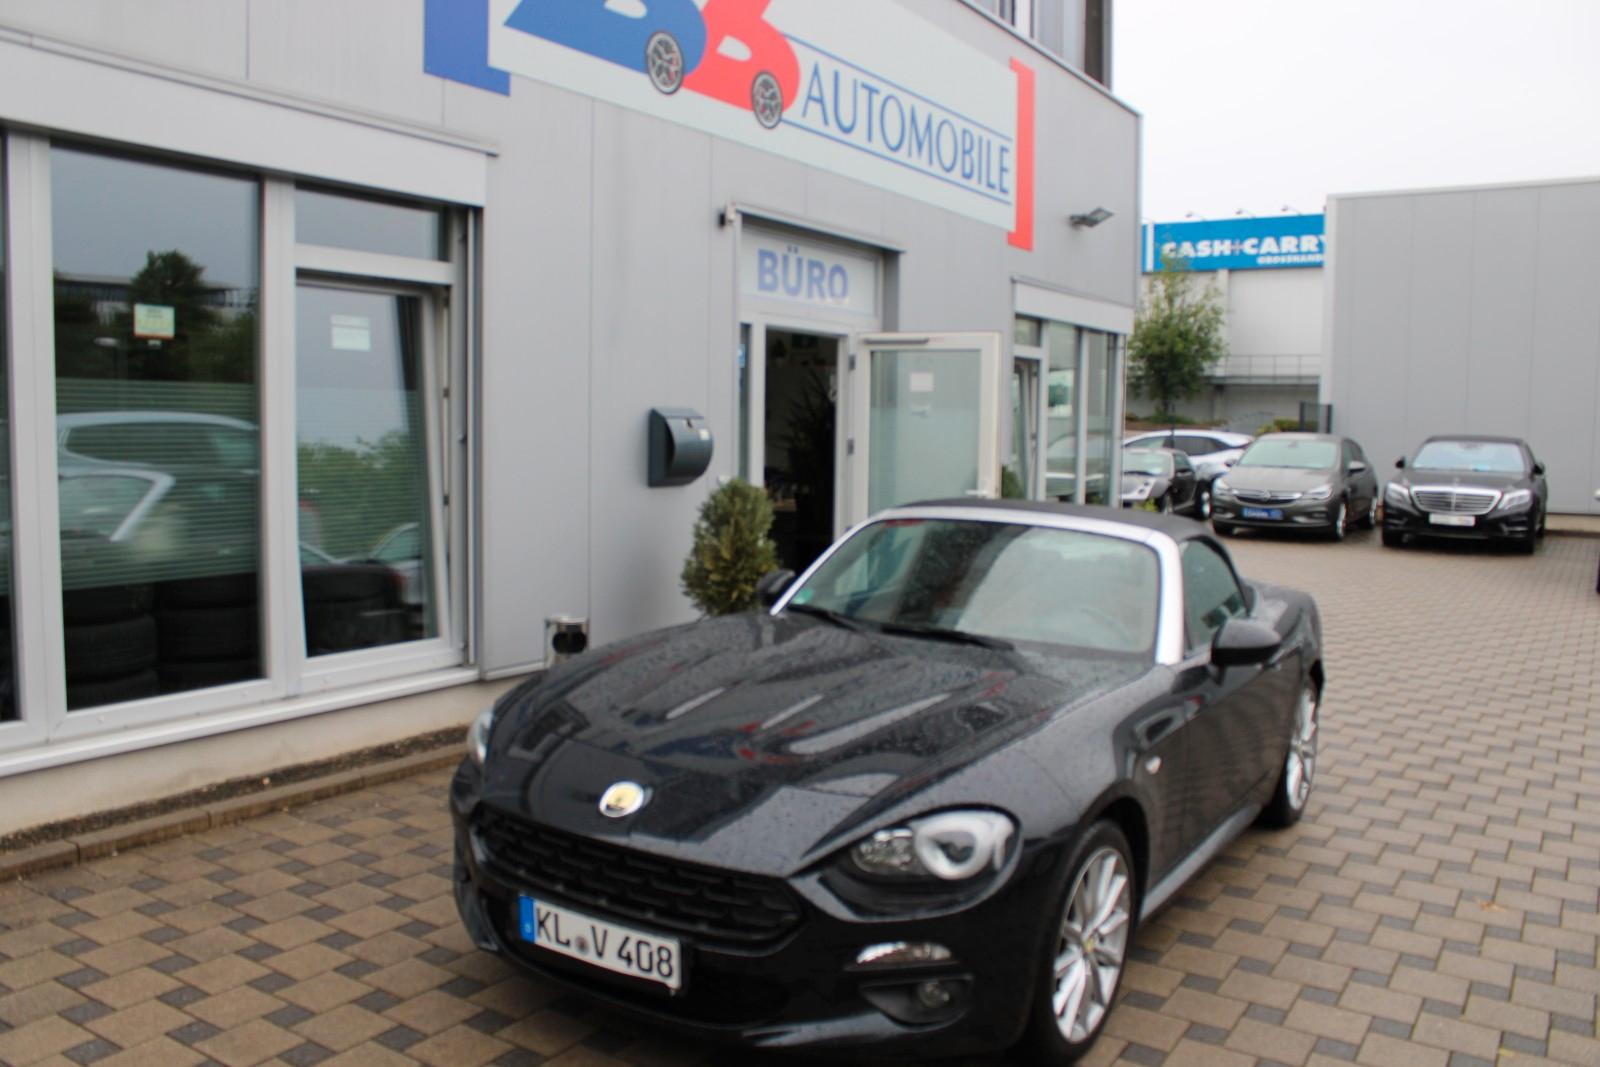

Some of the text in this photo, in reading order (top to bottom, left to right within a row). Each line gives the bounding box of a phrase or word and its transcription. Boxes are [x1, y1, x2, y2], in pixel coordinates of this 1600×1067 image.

[802, 62, 1010, 194] AUTOMOBILE
[757, 246, 849, 301] BÜRO
[536, 907, 674, 979] KL V 408
